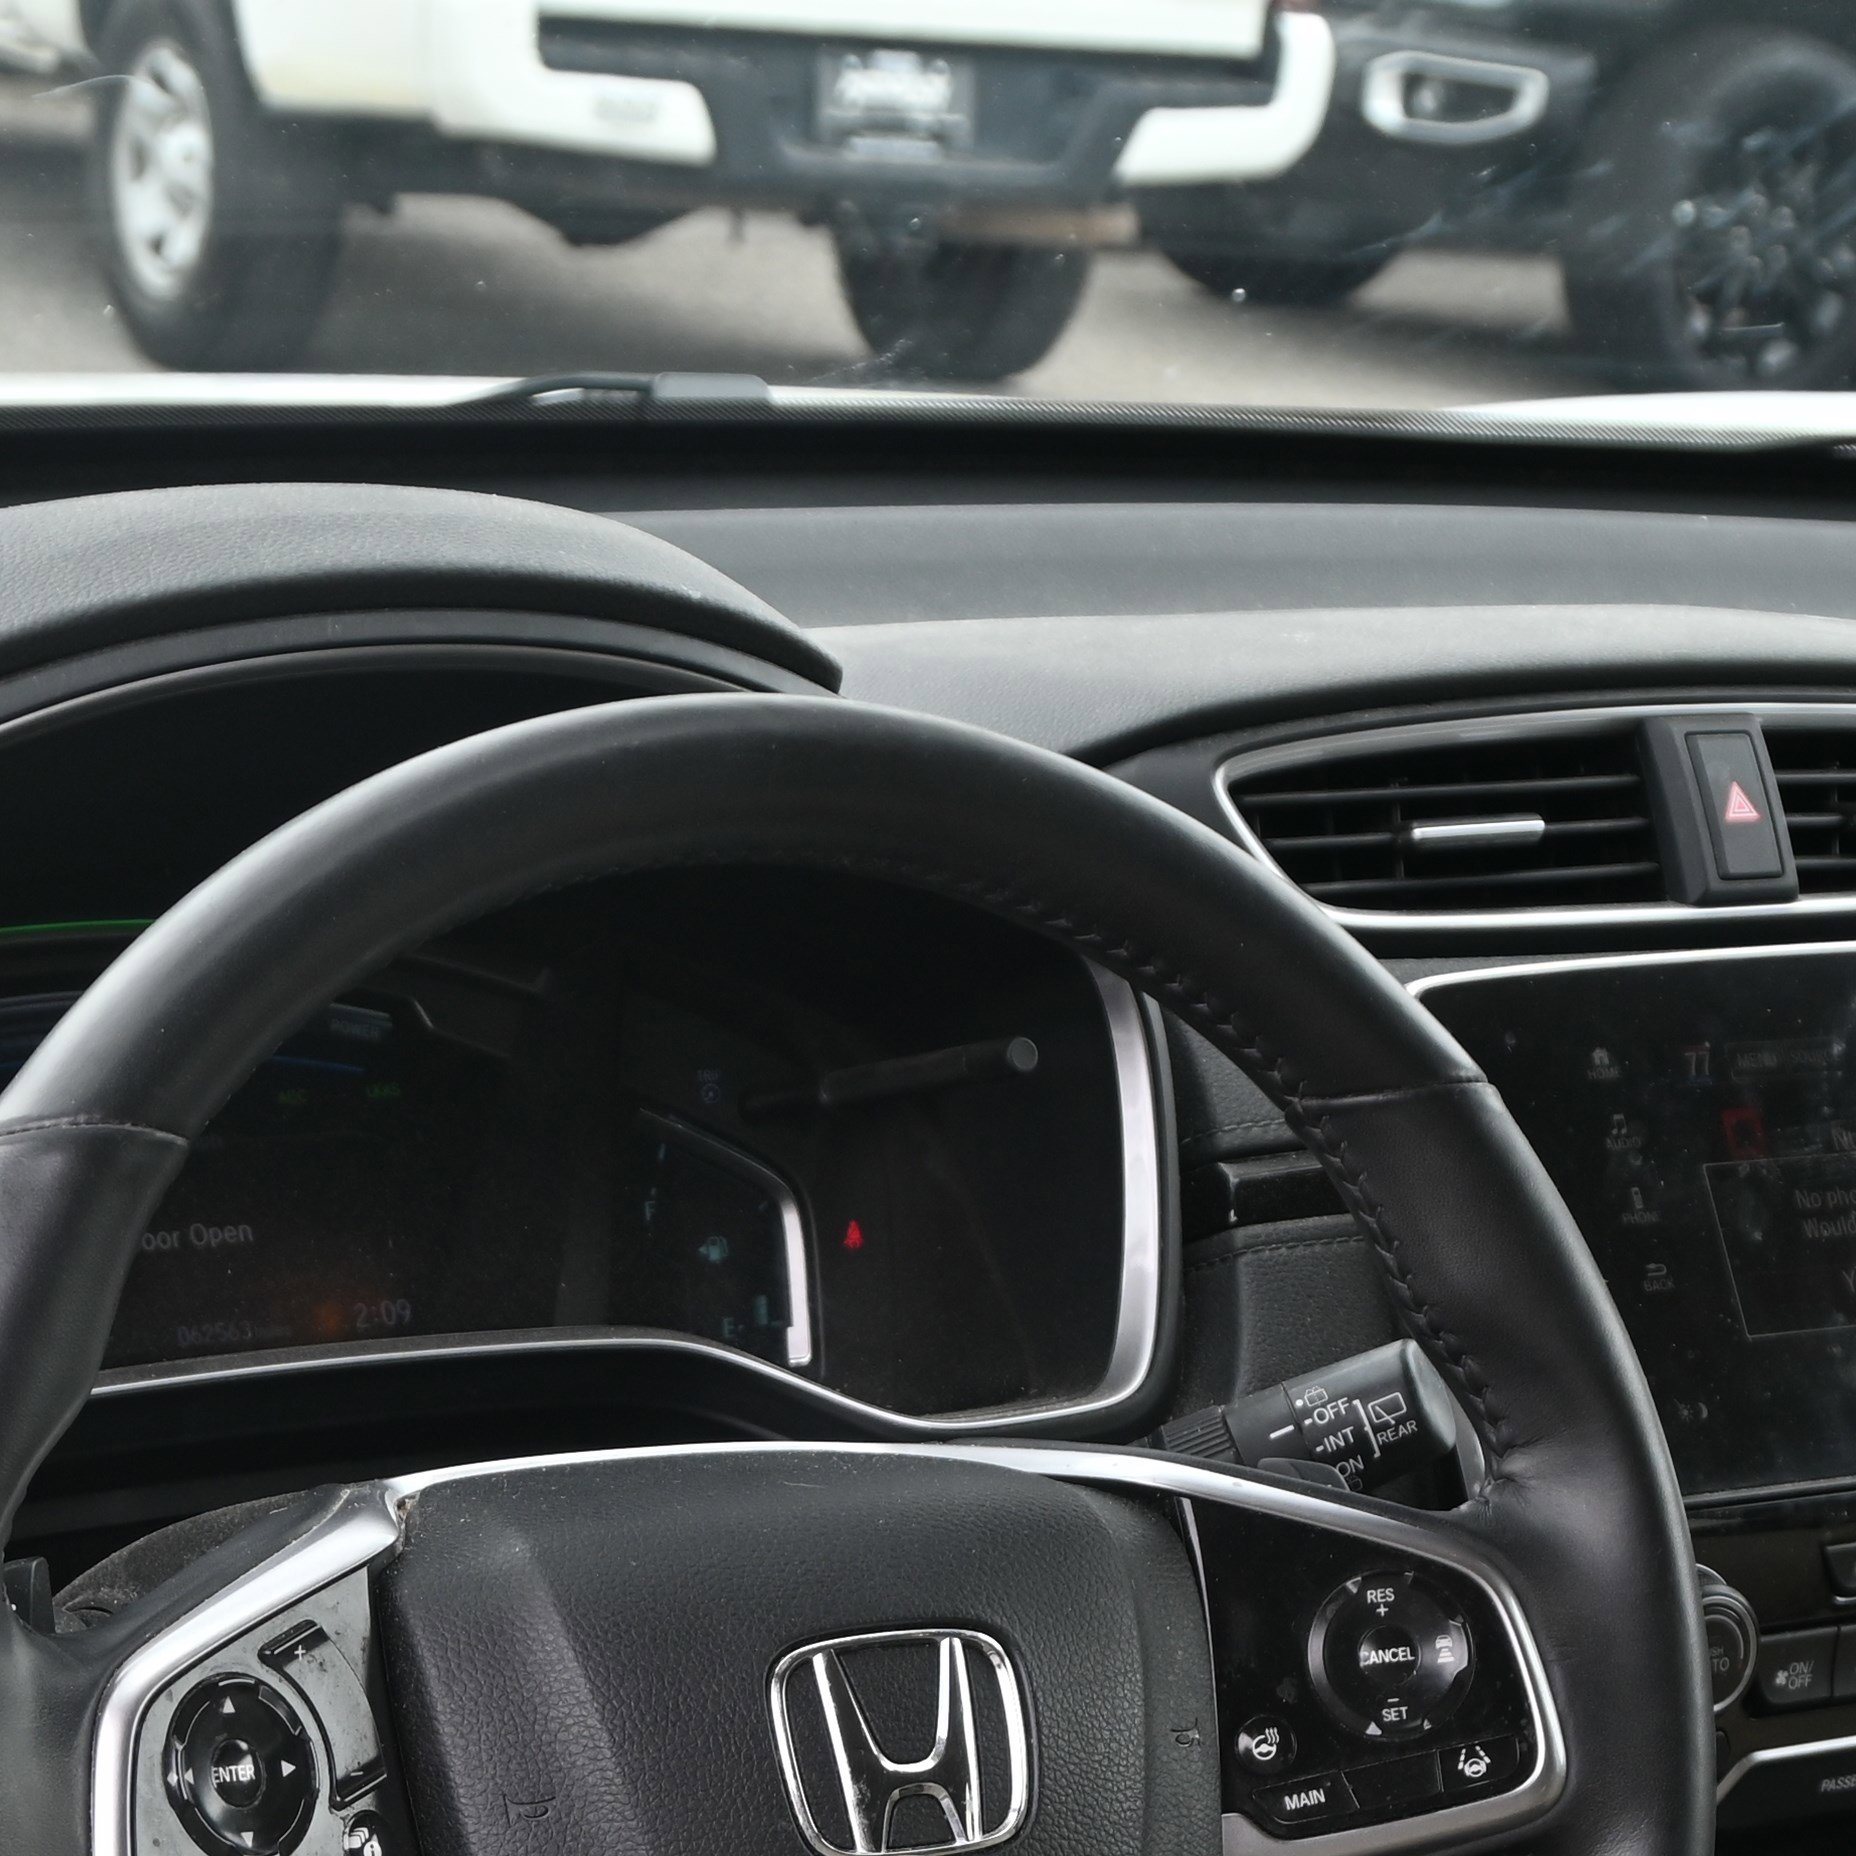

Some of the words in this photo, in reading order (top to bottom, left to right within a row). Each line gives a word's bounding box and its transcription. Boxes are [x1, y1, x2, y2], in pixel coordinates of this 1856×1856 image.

[1605, 1136, 1643, 1151] AUDIO
[1795, 1188, 1823, 1209] No
[141, 1230, 180, 1251] oor
[189, 1222, 254, 1248] Open
[1643, 1278, 1676, 1293] BACK
[351, 1297, 412, 1332] 2:09
[1312, 1397, 1351, 1427] OFF
[1322, 1425, 1357, 1450] INT
[1375, 1419, 1419, 1446] REAR
[1335, 1454, 1366, 1478] ON
[1366, 1587, 1396, 1605] RES
[1359, 1645, 1417, 1668] CANCEL
[1788, 1659, 1816, 1676] ON/
[1787, 1674, 1814, 1690] OFF
[1381, 1705, 1409, 1723] SET
[211, 1764, 256, 1785] ENTER
[1283, 1788, 1326, 1811] MAIN
